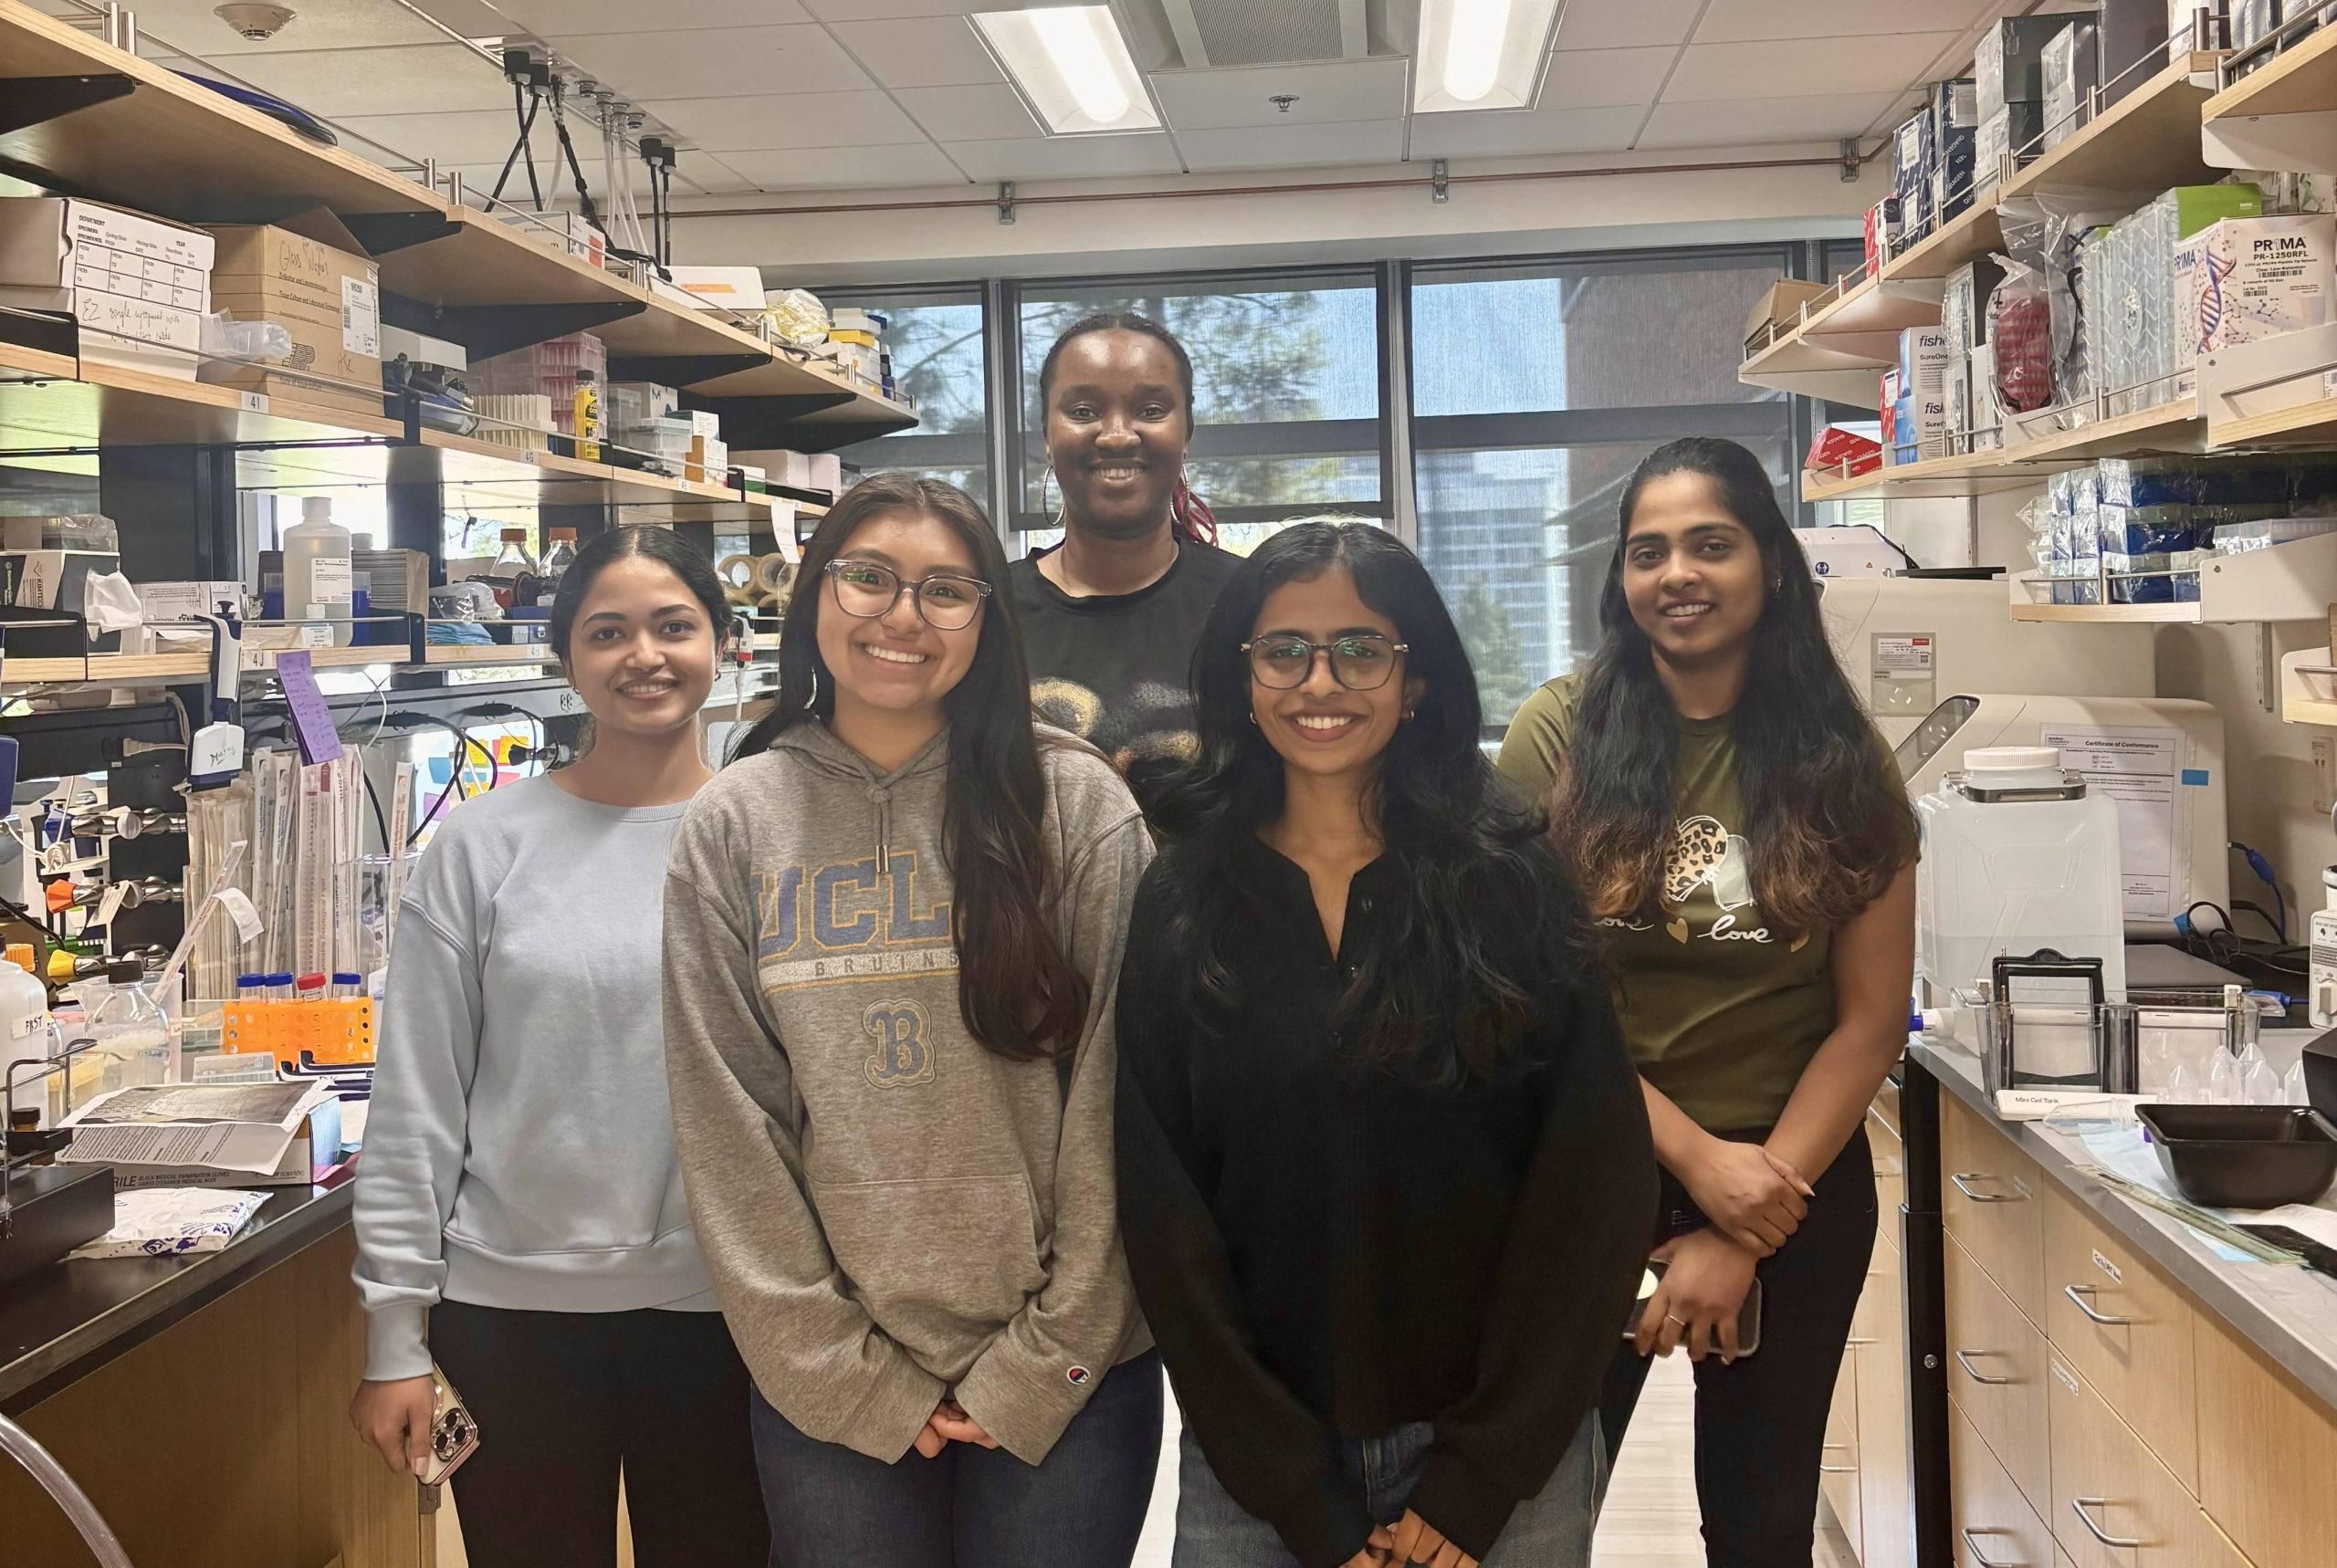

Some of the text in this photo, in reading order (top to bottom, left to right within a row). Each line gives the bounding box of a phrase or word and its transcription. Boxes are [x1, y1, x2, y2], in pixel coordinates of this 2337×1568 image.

[2253, 250, 2309, 260] PR-1250RFL
[652, 389, 661, 401] M
[253, 653, 265, 666] 4J
[750, 851, 965, 959] UCL
[1697, 914, 1775, 943] love
[814, 950, 959, 977] BRUINS
[864, 998, 936, 1087] B
